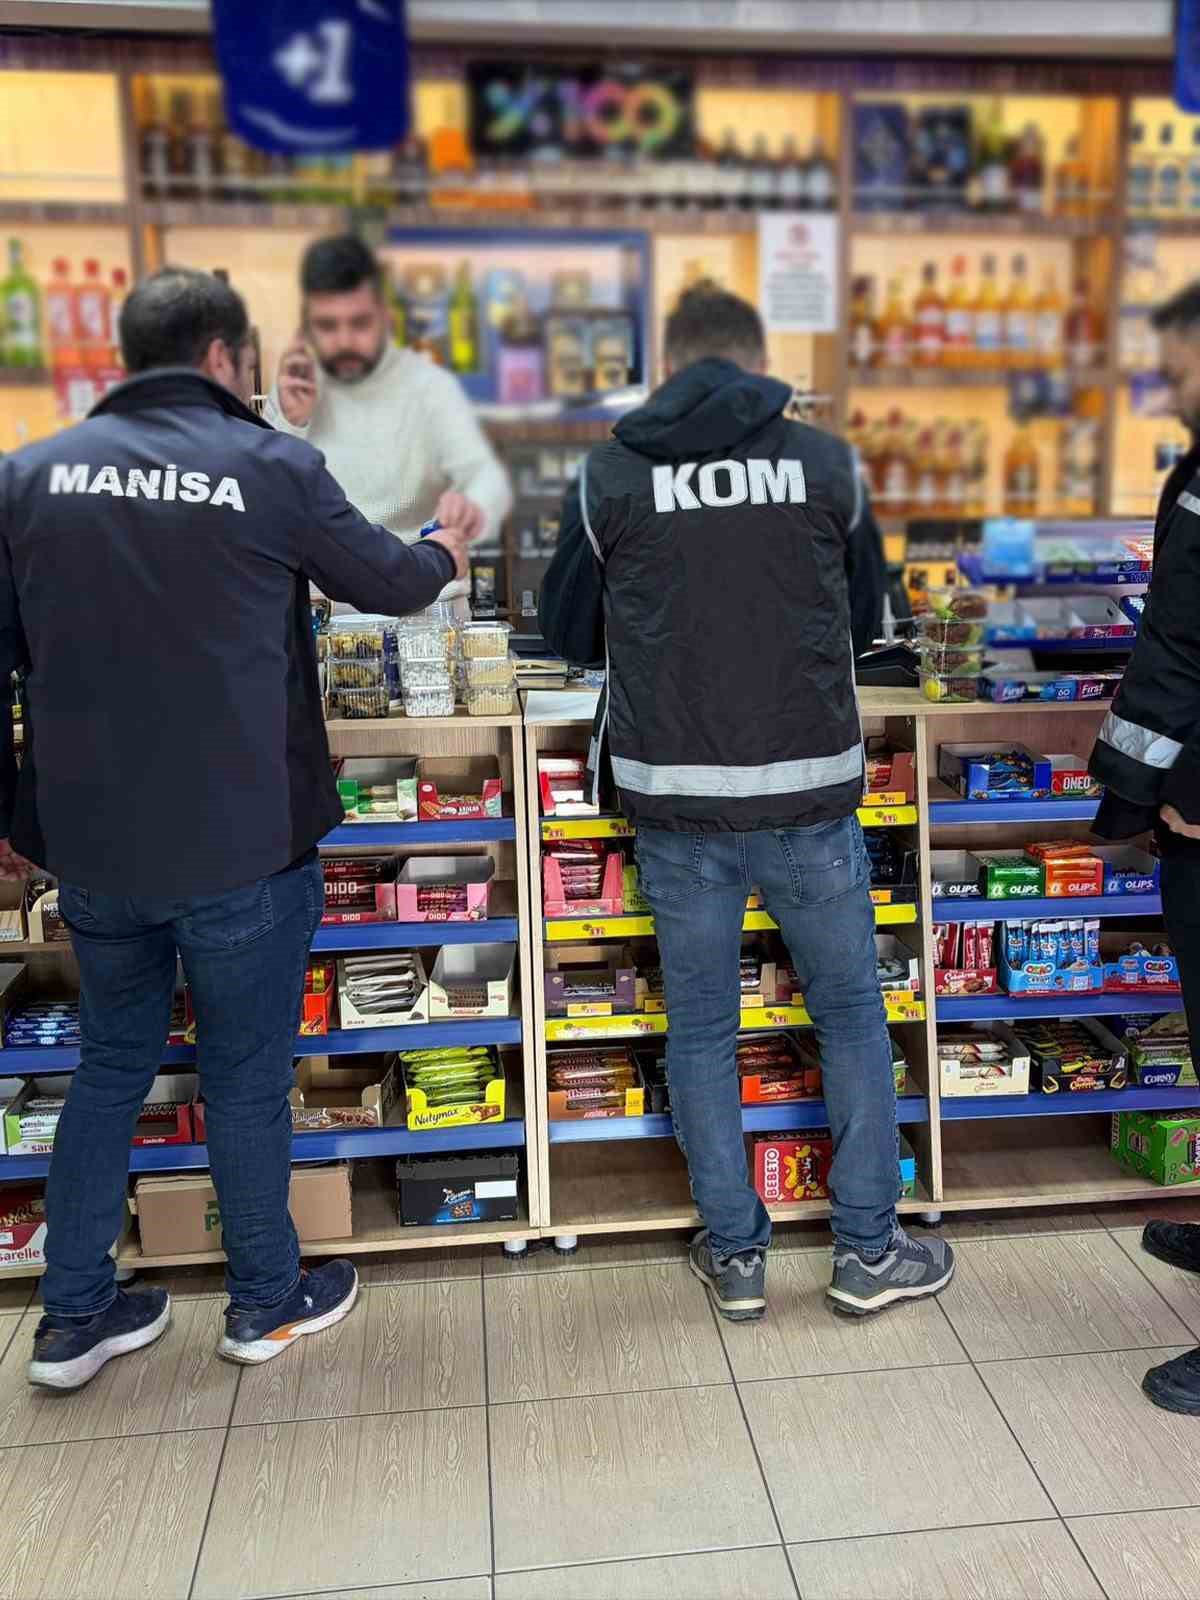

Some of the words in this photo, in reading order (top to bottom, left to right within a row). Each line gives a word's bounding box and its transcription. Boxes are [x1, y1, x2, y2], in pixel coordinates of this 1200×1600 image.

[49, 464, 246, 512] MANİSA
[651, 458, 807, 513] KOM
[1081, 682, 1104, 694] First
[1063, 776, 1090, 790] ONEO
[414, 1107, 459, 1126] Nutymax
[766, 1149, 779, 1197] BEBETO
